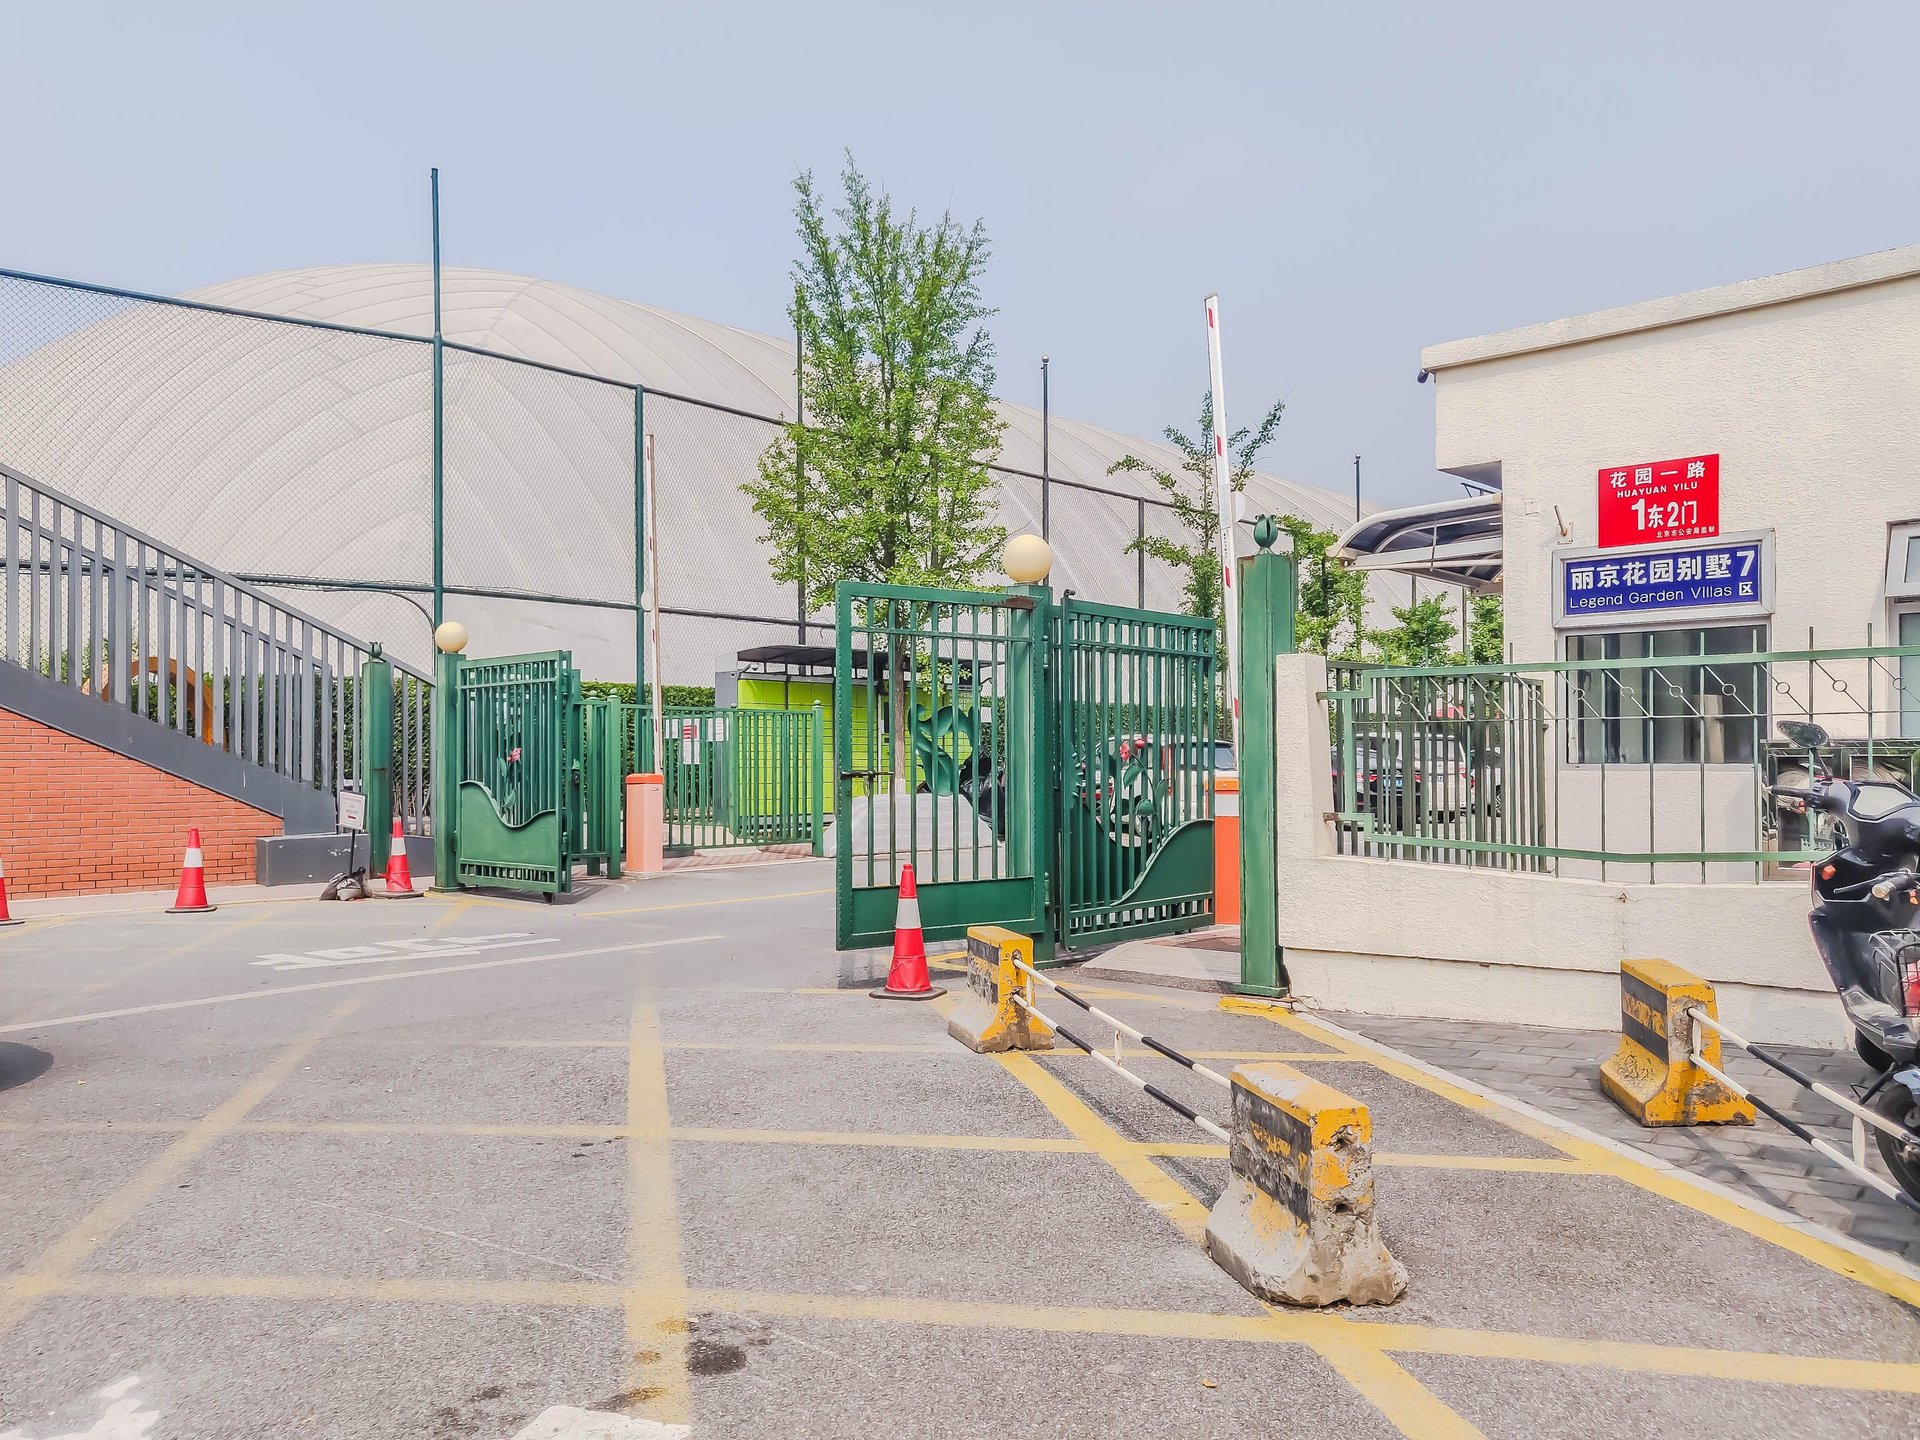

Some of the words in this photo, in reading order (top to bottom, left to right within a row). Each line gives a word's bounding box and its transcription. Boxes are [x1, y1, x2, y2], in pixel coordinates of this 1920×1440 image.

[1609, 460, 1706, 489] 花园一路
[1617, 485, 1667, 498] HUAYUAN
[1673, 481, 1698, 492] YILU
[1631, 498, 1698, 531] 1东2门
[1570, 593, 1623, 610] Legend
[1629, 585, 1684, 603] Garden
[1690, 585, 1733, 599] Villas
